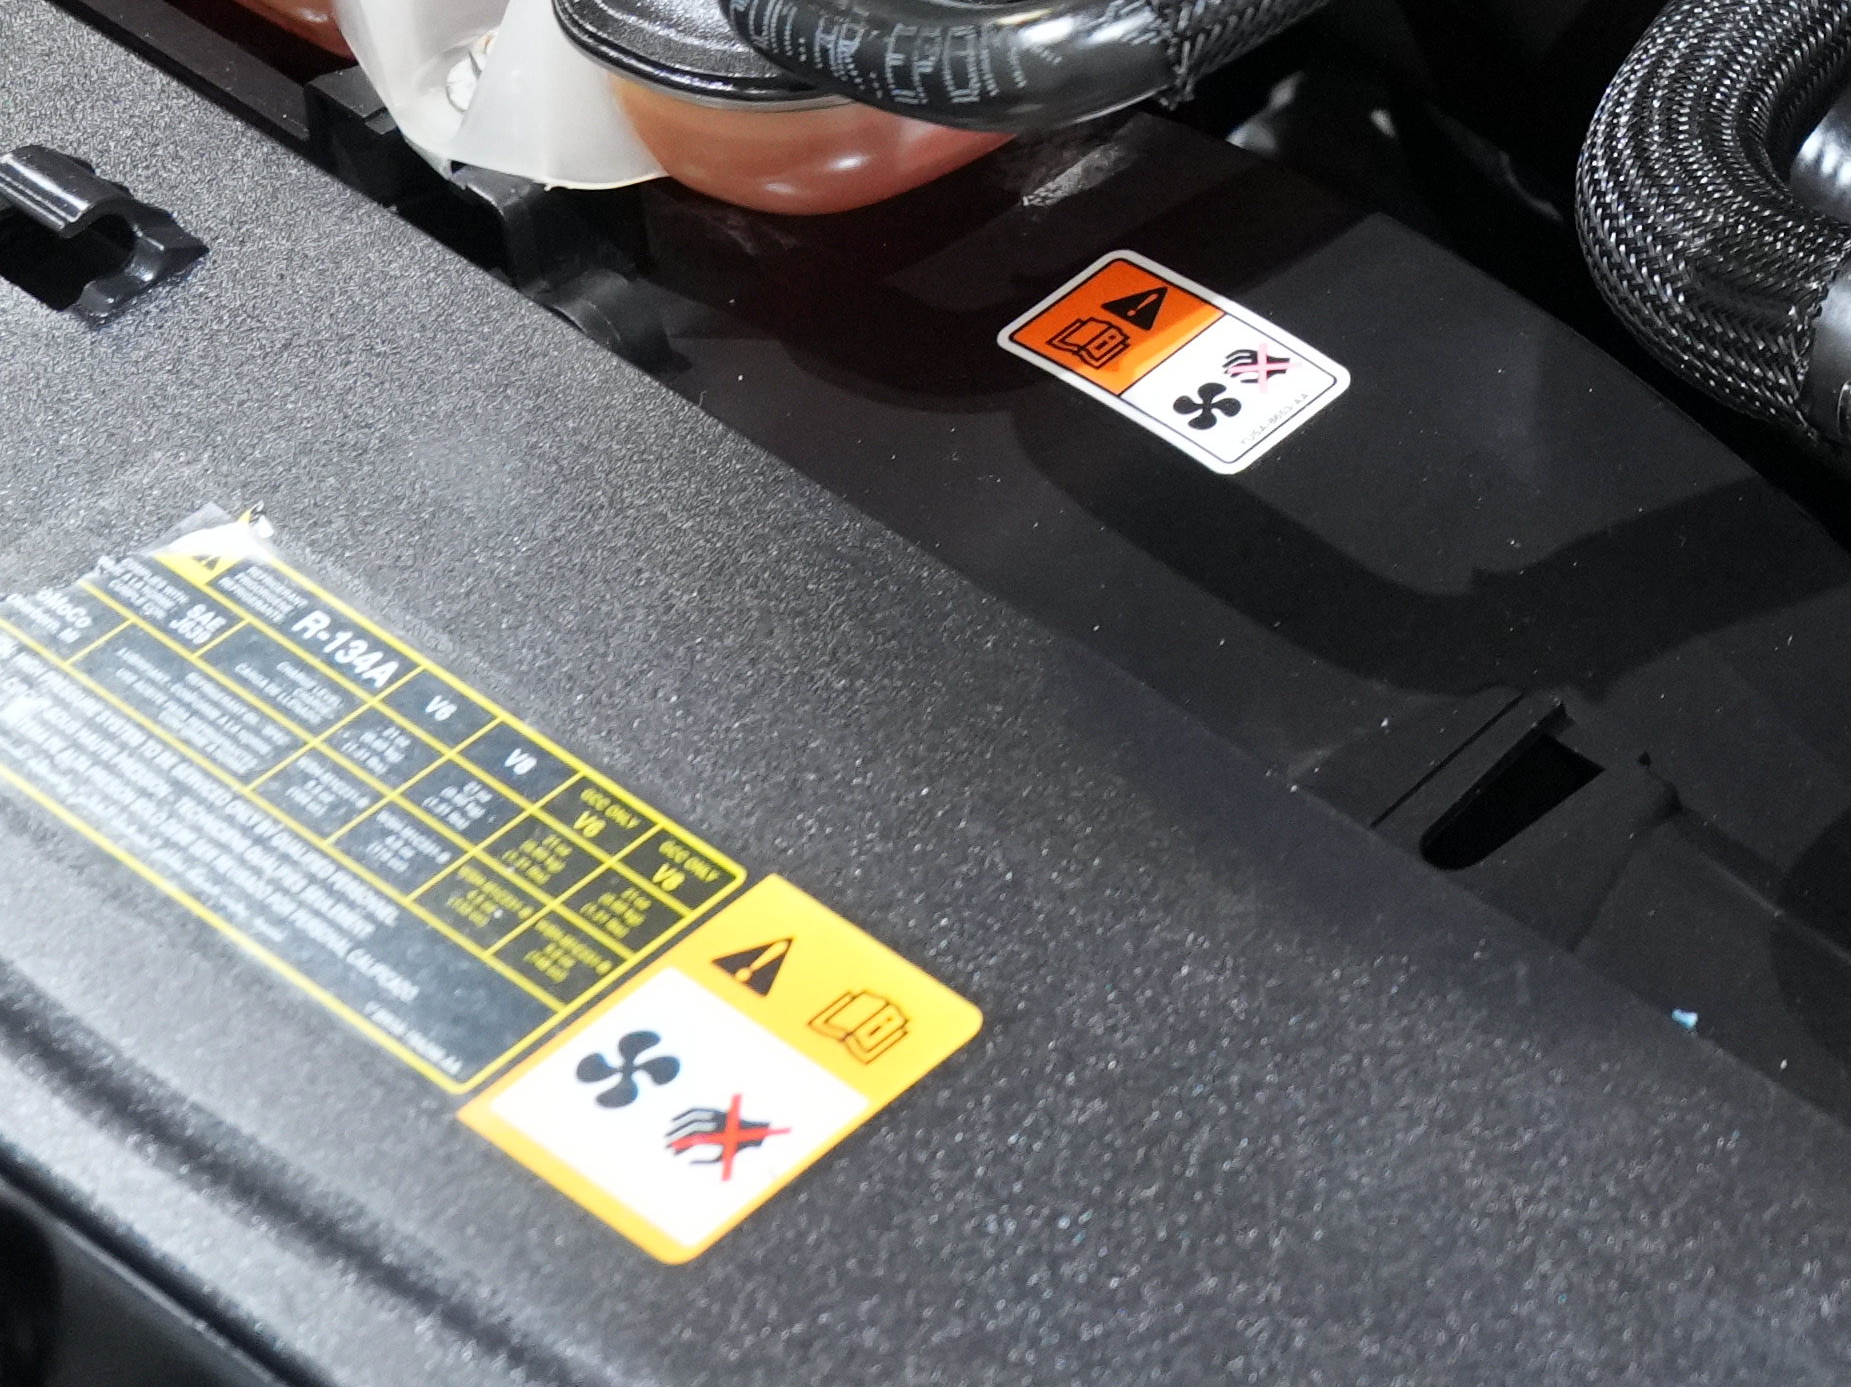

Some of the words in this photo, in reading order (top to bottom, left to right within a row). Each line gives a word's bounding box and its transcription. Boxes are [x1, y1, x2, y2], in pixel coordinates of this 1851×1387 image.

[166, 614, 213, 647] J639
[184, 602, 228, 633] SAE
[289, 608, 404, 689] R-134A
[419, 693, 460, 723] V6
[37, 669, 104, 717] PRESSURE
[93, 708, 148, 747] SYSTEM
[136, 738, 165, 758] TO
[153, 749, 181, 770] BE
[171, 762, 234, 806] SERVICED
[222, 797, 266, 829] ONLY
[268, 830, 339, 879] QUALIFIED
[498, 747, 540, 777] V8
[569, 810, 609, 839] V6
[602, 803, 641, 831] ONLY
[646, 863, 689, 893] V8
[680, 856, 721, 884] ONLY
